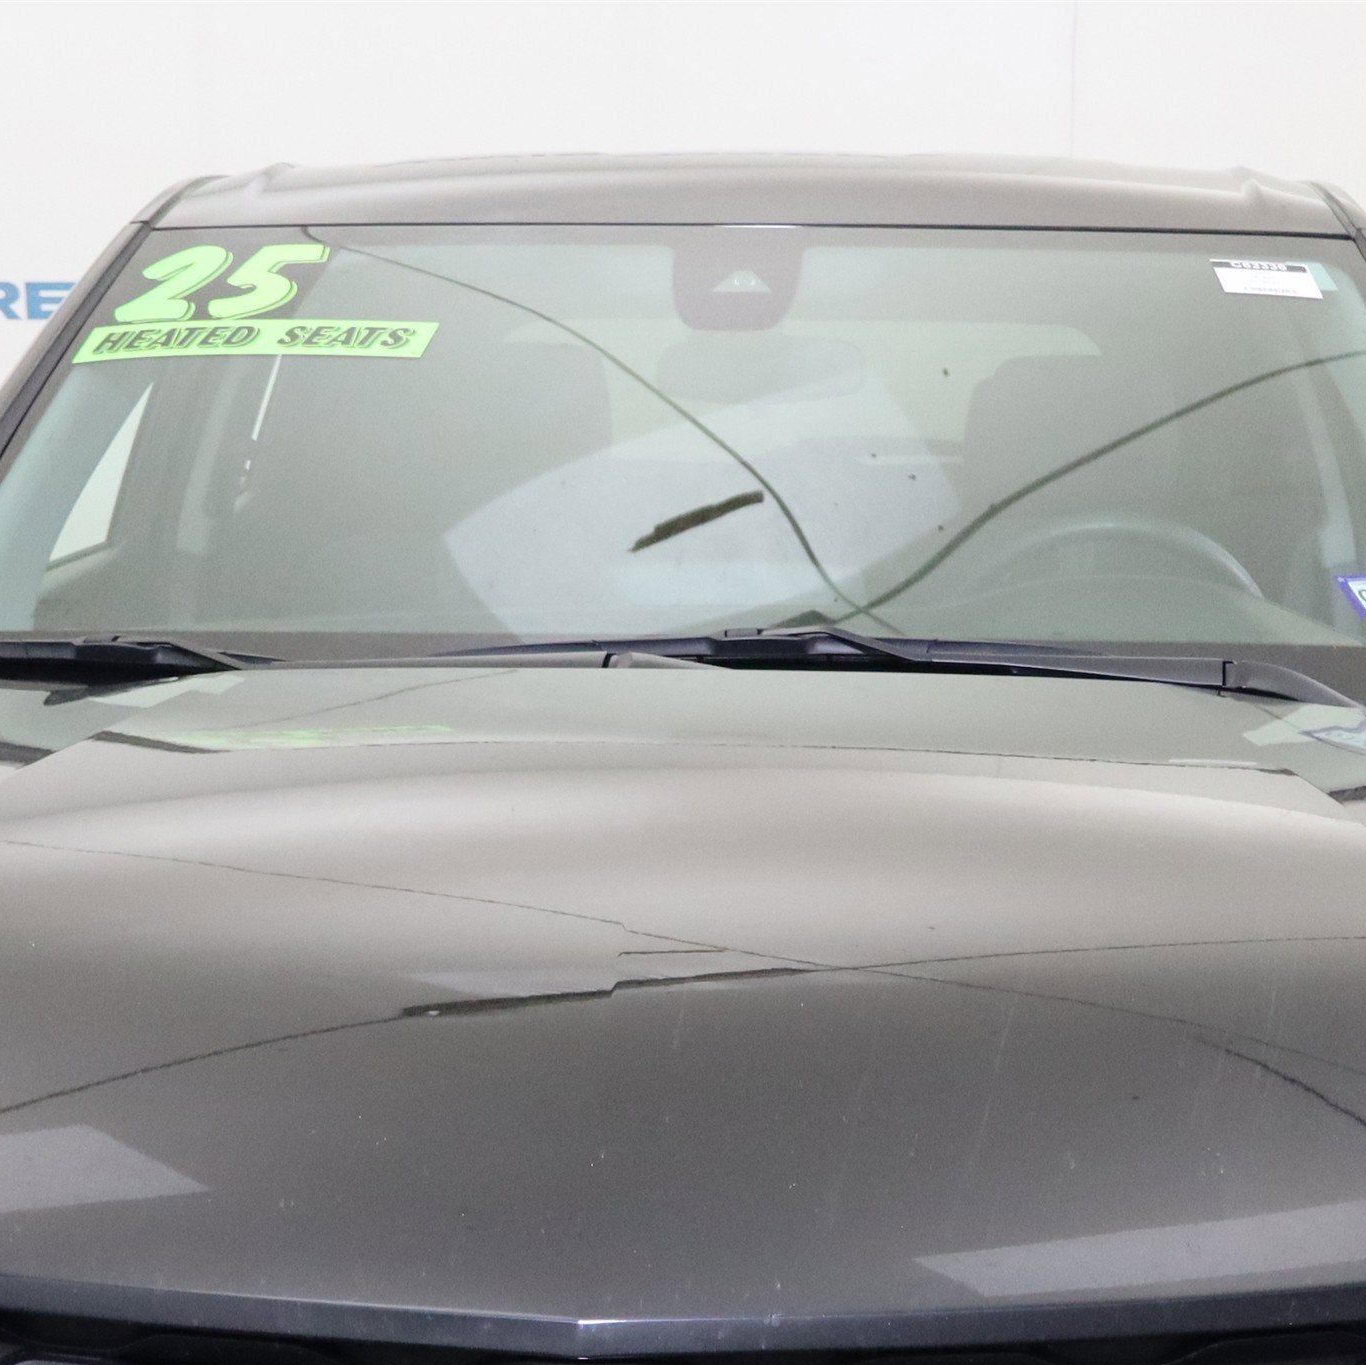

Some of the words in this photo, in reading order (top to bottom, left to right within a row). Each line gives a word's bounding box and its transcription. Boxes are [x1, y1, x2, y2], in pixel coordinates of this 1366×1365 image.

[114, 242, 330, 323] 25
[92, 325, 262, 355] HEATED
[276, 325, 419, 351] SEATS
